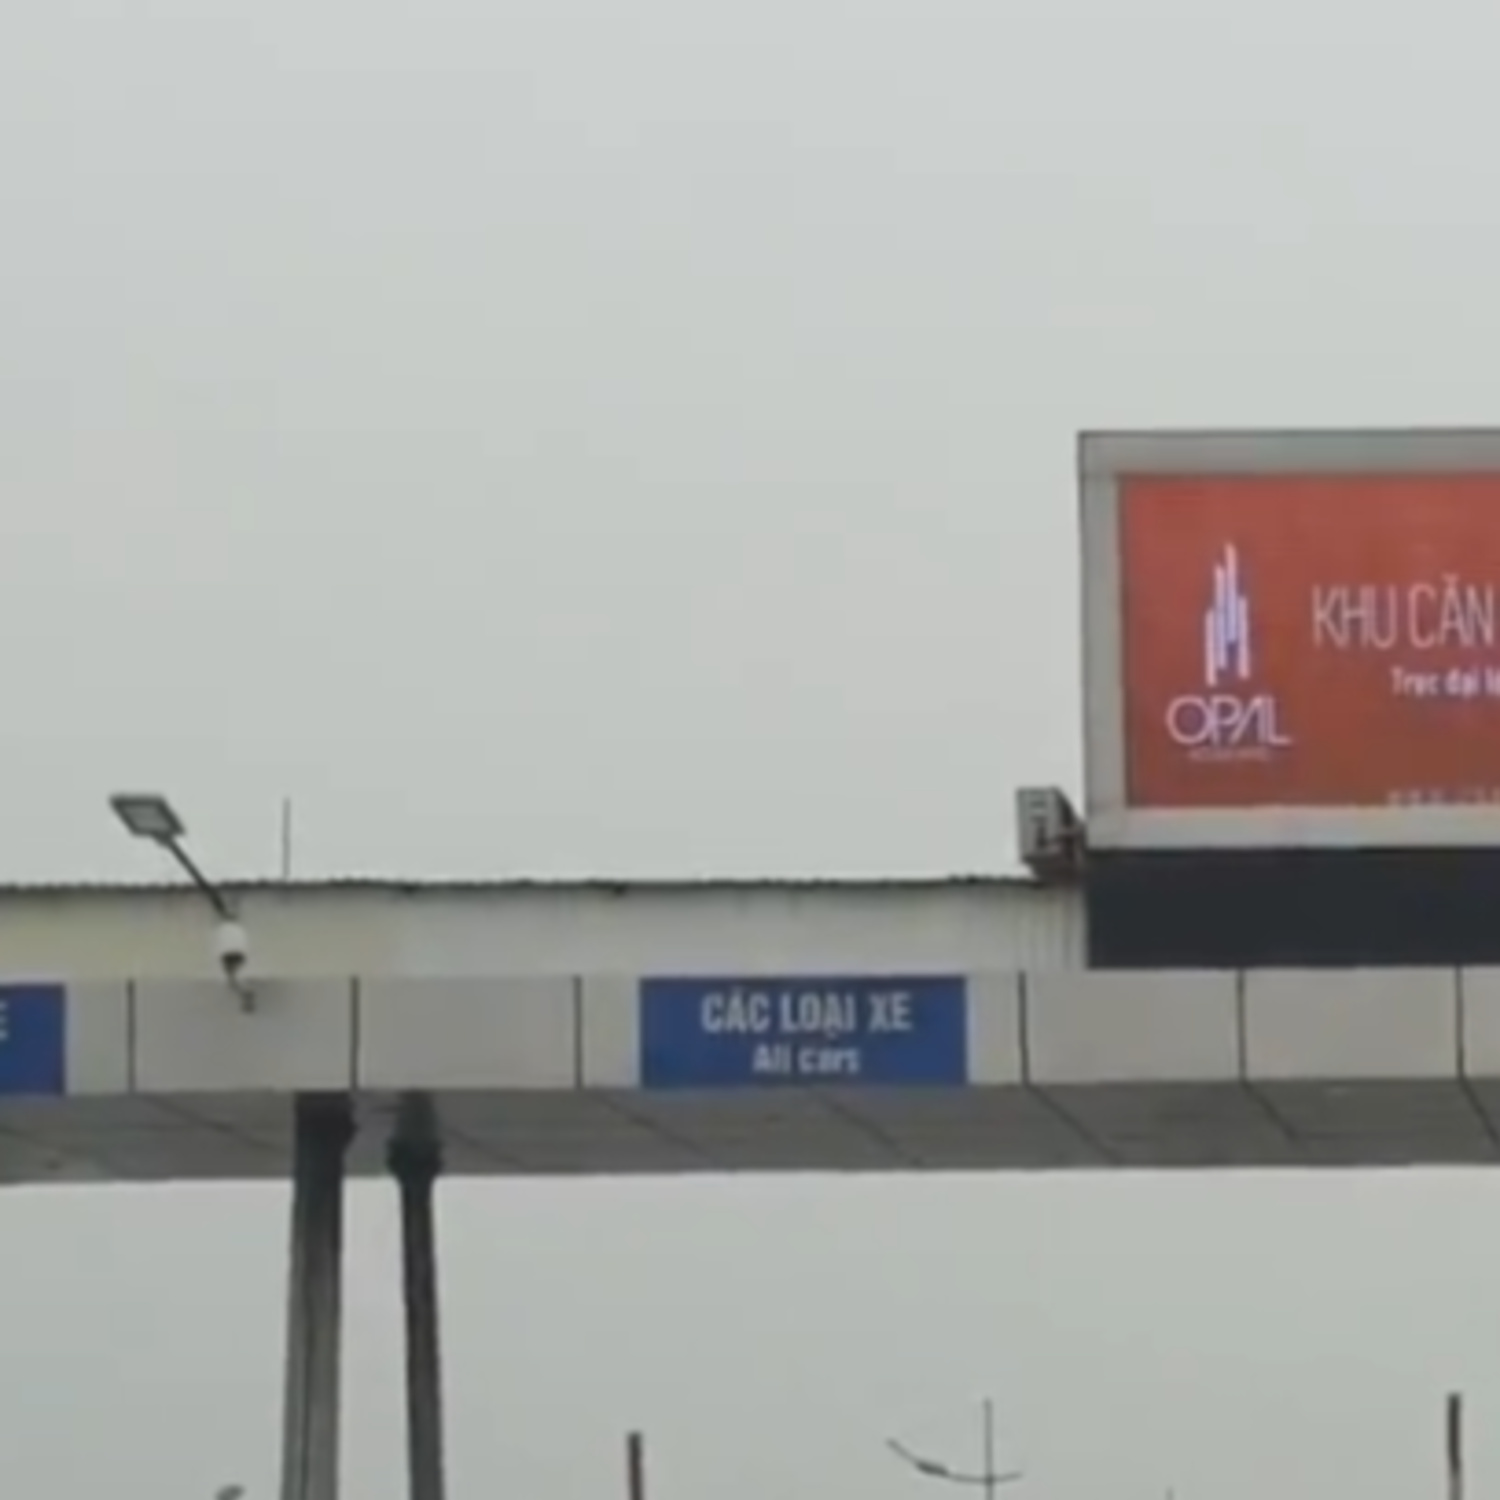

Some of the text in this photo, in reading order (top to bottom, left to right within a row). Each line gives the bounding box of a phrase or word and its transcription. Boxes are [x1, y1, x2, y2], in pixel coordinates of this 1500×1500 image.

[1312, 583, 1399, 651] KHU
[1408, 573, 1495, 651] CĂN
[1165, 694, 1293, 746] OPAL
[701, 986, 914, 1039] CÁC LOẠI XE
[752, 1042, 861, 1073] All cars
